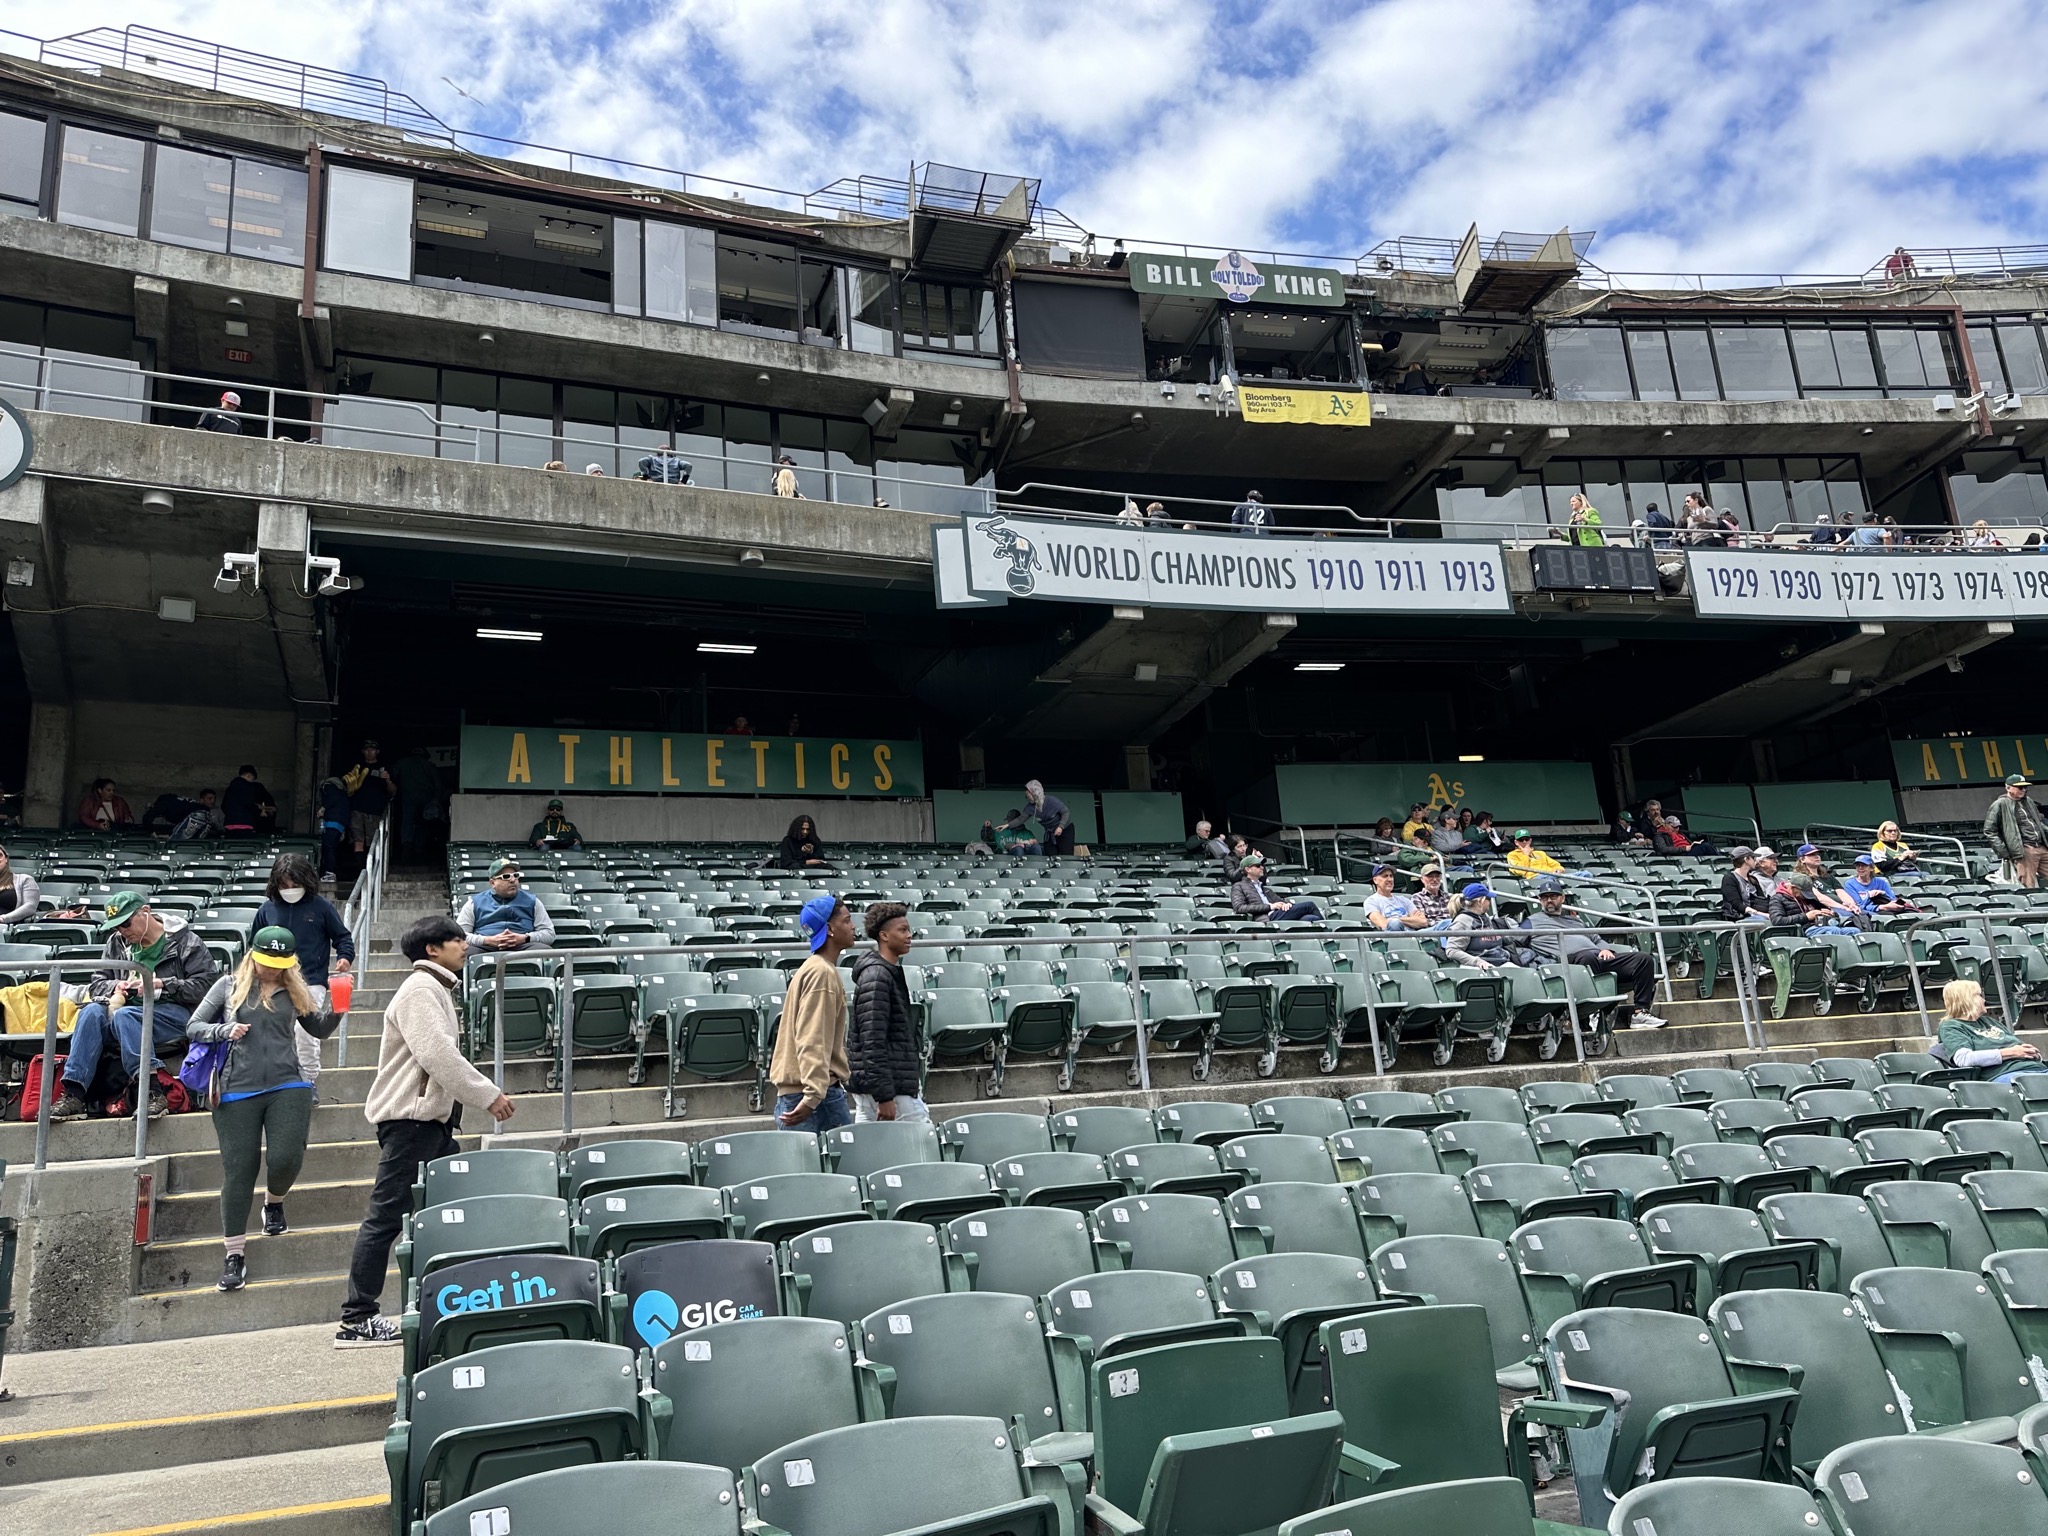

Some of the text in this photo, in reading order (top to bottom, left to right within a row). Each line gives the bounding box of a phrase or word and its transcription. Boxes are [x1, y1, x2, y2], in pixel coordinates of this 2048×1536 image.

[1146, 263, 1333, 297] BILL KING
[1212, 270, 1264, 286] HOLY TOLEDO!
[229, 350, 248, 361] EXIT
[1245, 393, 1292, 402] Bloomberg
[1328, 394, 1354, 417] A's
[1248, 508, 1265, 525] 22
[1046, 542, 1495, 592] WORLD CHAMPIONS 1910 1911 1913
[1706, 567, 1759, 598] 1929
[1769, 569, 1822, 601] 1930
[1831, 571, 1884, 601] 1972
[1891, 572, 1945, 601] 1973
[1953, 571, 2004, 600] 1974
[507, 732, 893, 790] ATHLETICS
[1922, 738, 2048, 781] ATHL
[1428, 772, 1465, 811] A's
[270, 939, 286, 950] A's
[594, 1153, 601, 1162] 2
[890, 1176, 897, 1185] 4
[613, 1199, 619, 1209] 2
[1117, 1210, 1124, 1221] 5
[974, 1223, 981, 1234] 4
[819, 1239, 825, 1251] 3
[1241, 1273, 1249, 1286] 5
[437, 1271, 556, 1317] Get in.
[1078, 1292, 1085, 1305] 4
[681, 1299, 737, 1329] GIG
[739, 1304, 755, 1313] CAR
[739, 1309, 764, 1320] SHARE
[896, 1317, 904, 1333] 3
[1350, 1331, 1359, 1350] 4
[1574, 1332, 1584, 1349] 5
[693, 1342, 702, 1359] 2
[465, 1369, 472, 1387] 1
[1119, 1373, 1128, 1393] 3
[793, 1462, 805, 1483] 2
[485, 1511, 494, 1536] 1
